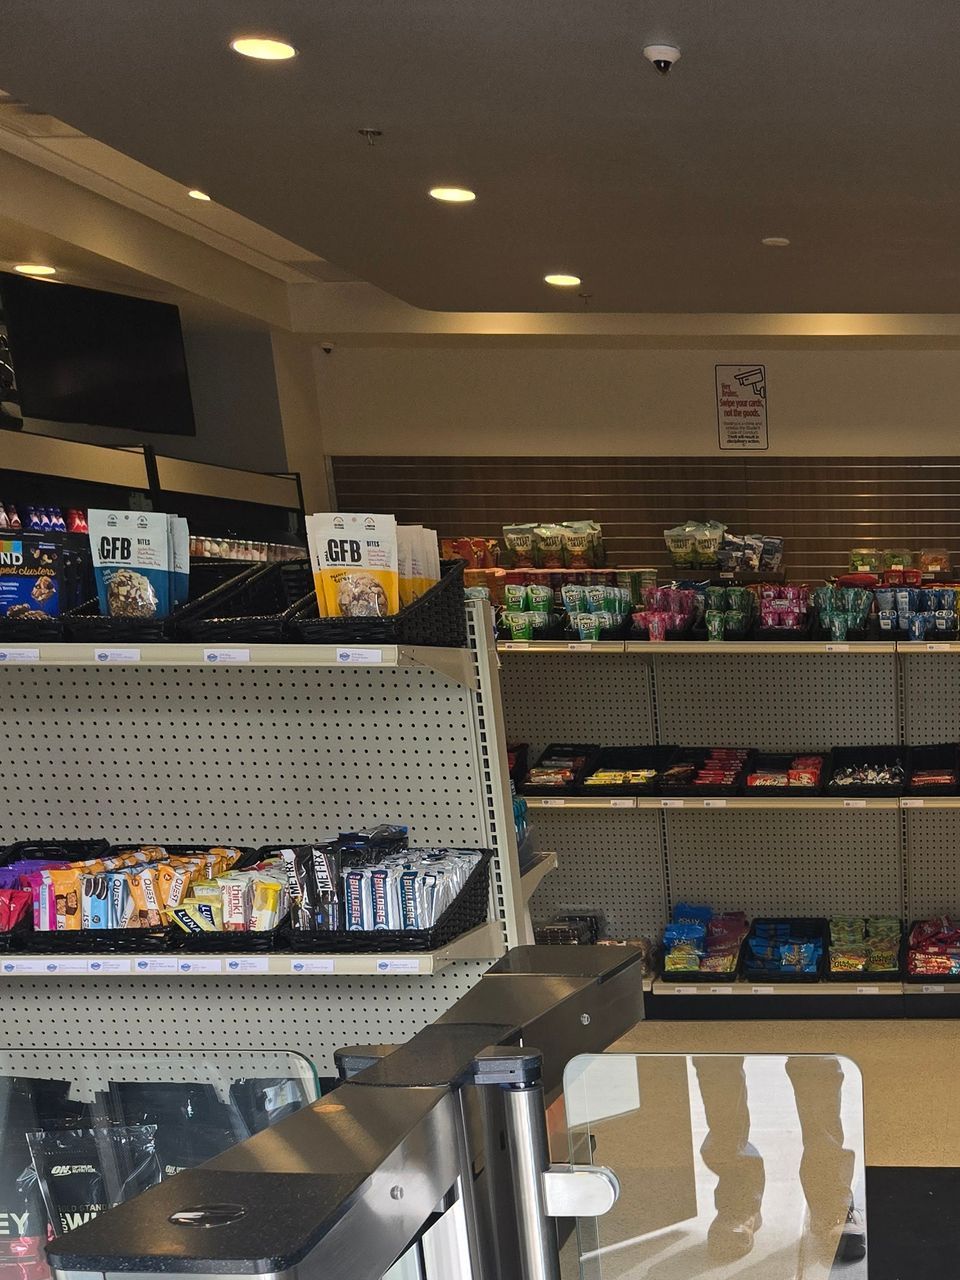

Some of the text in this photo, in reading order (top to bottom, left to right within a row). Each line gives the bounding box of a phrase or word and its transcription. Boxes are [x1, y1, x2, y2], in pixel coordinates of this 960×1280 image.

[0, 552, 24, 565] ND
[100, 536, 131, 560] GFB
[327, 538, 362, 563] GFB
[18, 566, 57, 576] clusters
[143, 878, 156, 905] QUEST
[172, 877, 184, 904] QUEST
[231, 884, 243, 916] think!
[350, 879, 361, 924] BUILDERS
[375, 879, 386, 924] BUILDERS
[404, 880, 415, 926] BUILDERS
[178, 911, 201, 932] LUNA
[0, 1213, 30, 1235] EY
